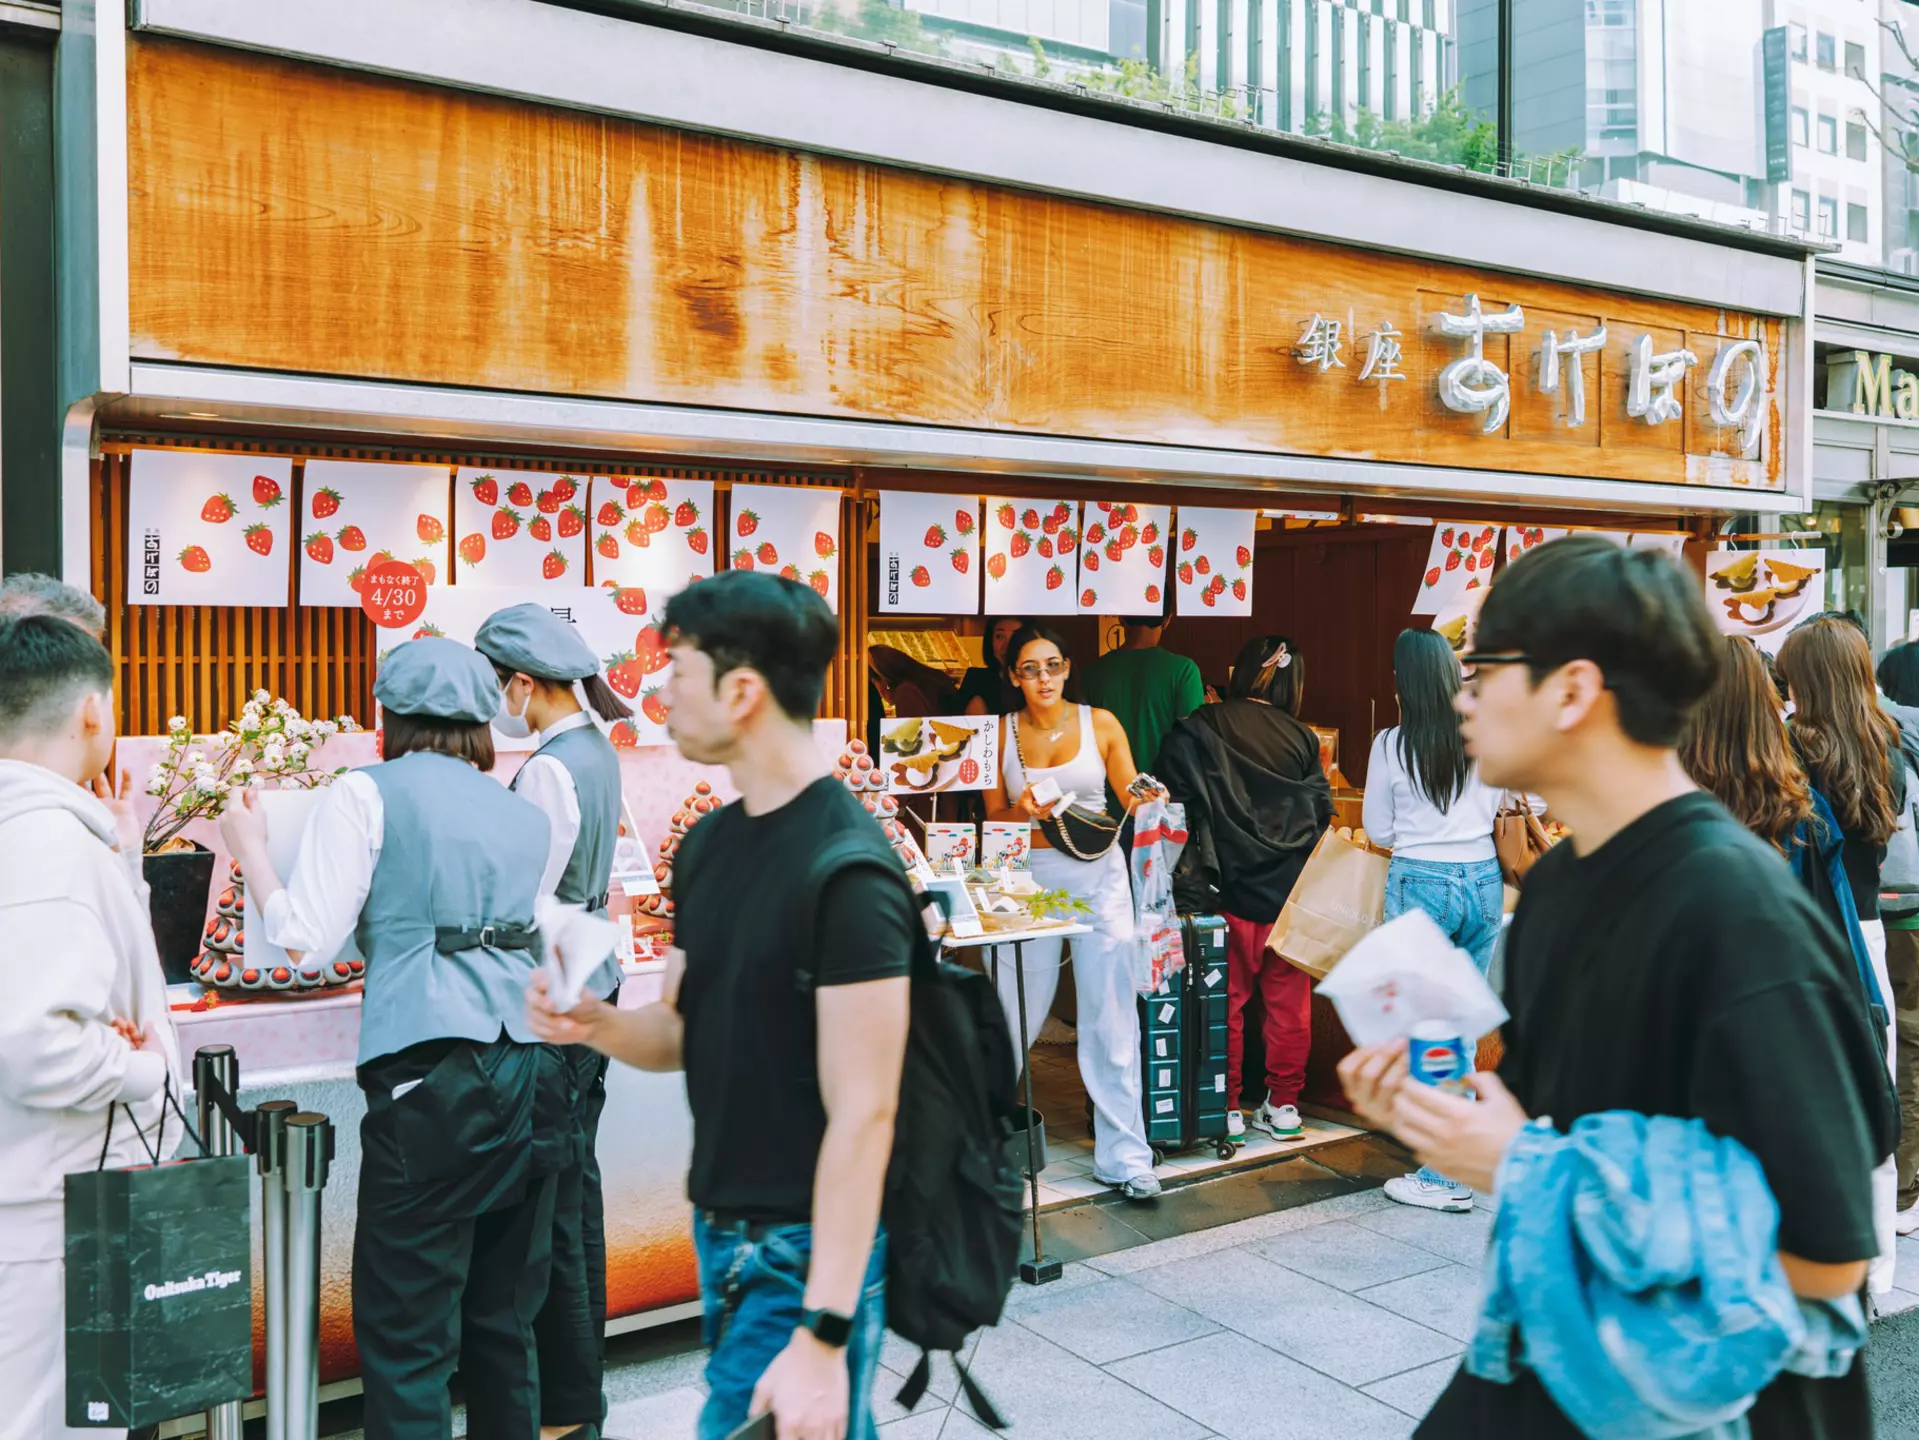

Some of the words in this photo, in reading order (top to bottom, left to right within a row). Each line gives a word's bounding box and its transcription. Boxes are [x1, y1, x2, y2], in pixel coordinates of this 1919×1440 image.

[1296, 313, 1407, 381] 銀座
[370, 574, 420, 586] まもなく終了
[371, 587, 416, 608] 4/30
[383, 608, 405, 620] まで
[983, 720, 994, 786] かしわもち
[205, 1270, 241, 1289] Tiger
